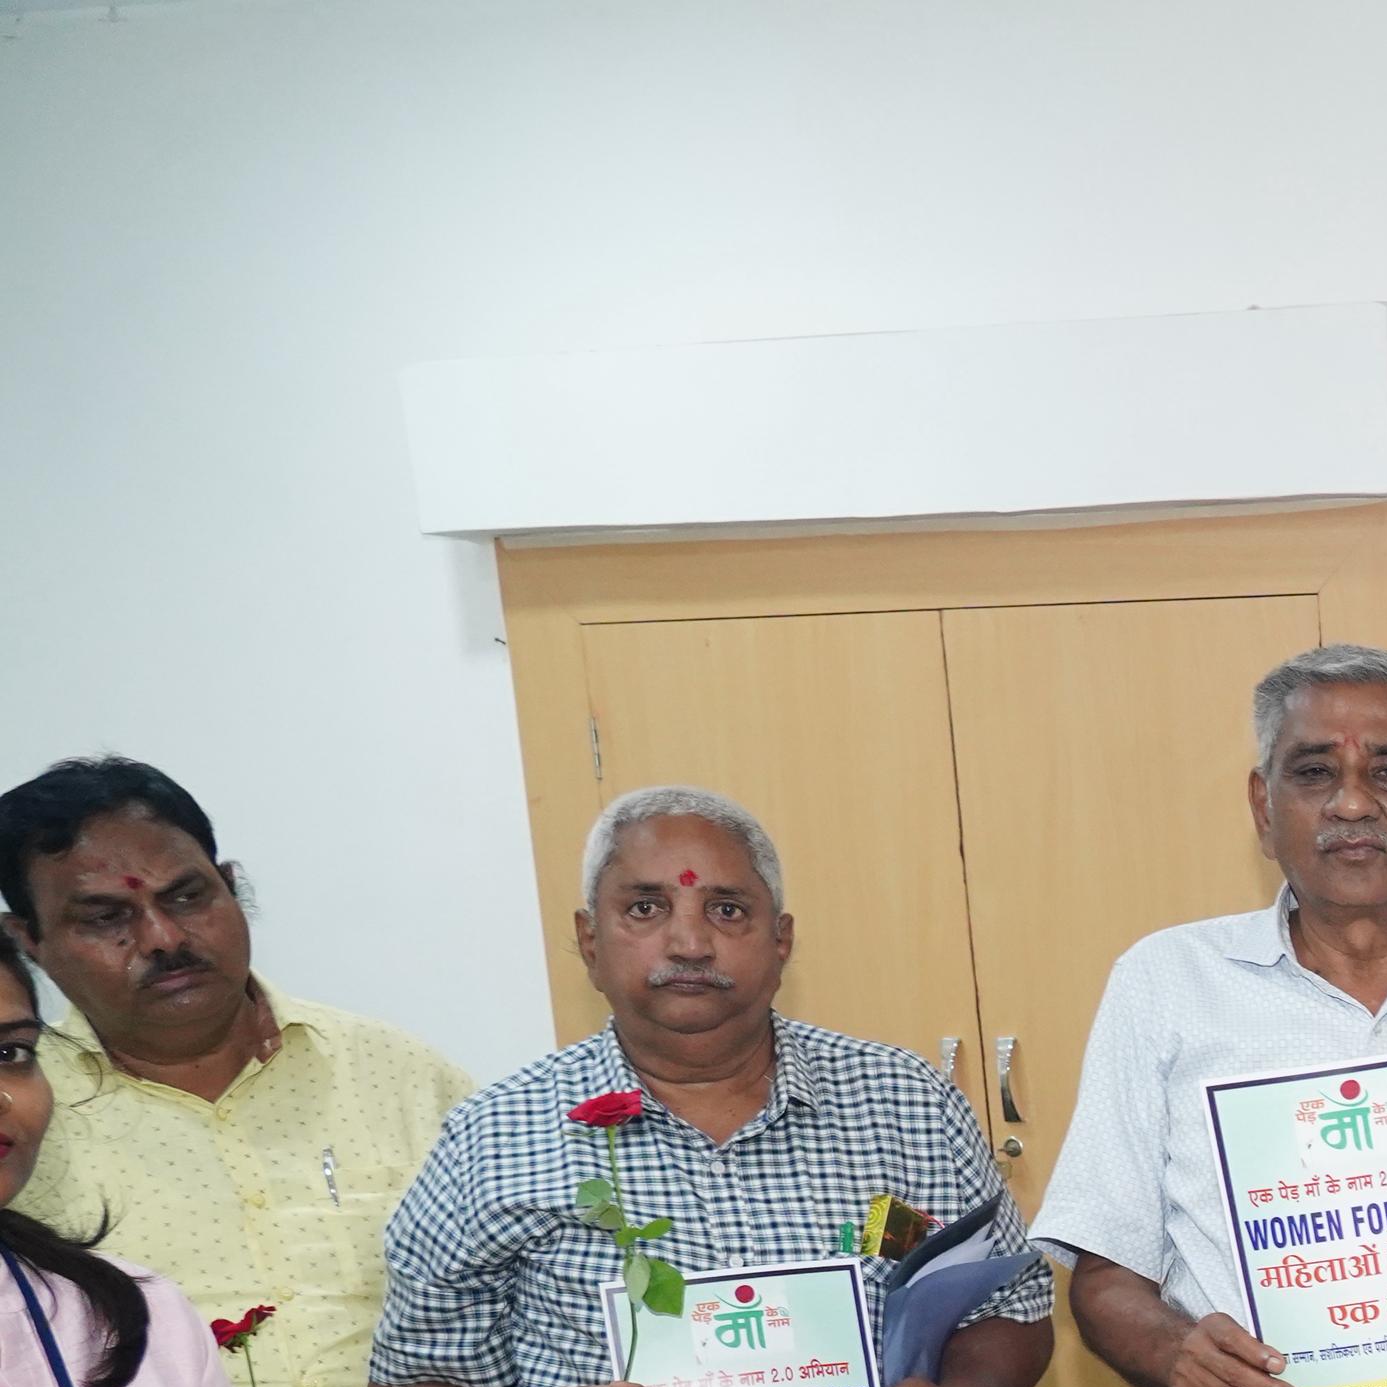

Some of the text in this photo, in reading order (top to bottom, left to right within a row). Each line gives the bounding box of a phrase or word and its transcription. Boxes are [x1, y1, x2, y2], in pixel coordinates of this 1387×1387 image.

[1244, 1209, 1343, 1250] WOMEN
[1257, 1244, 1381, 1289] महिलाओं
[1326, 1299, 1379, 1329] एक
